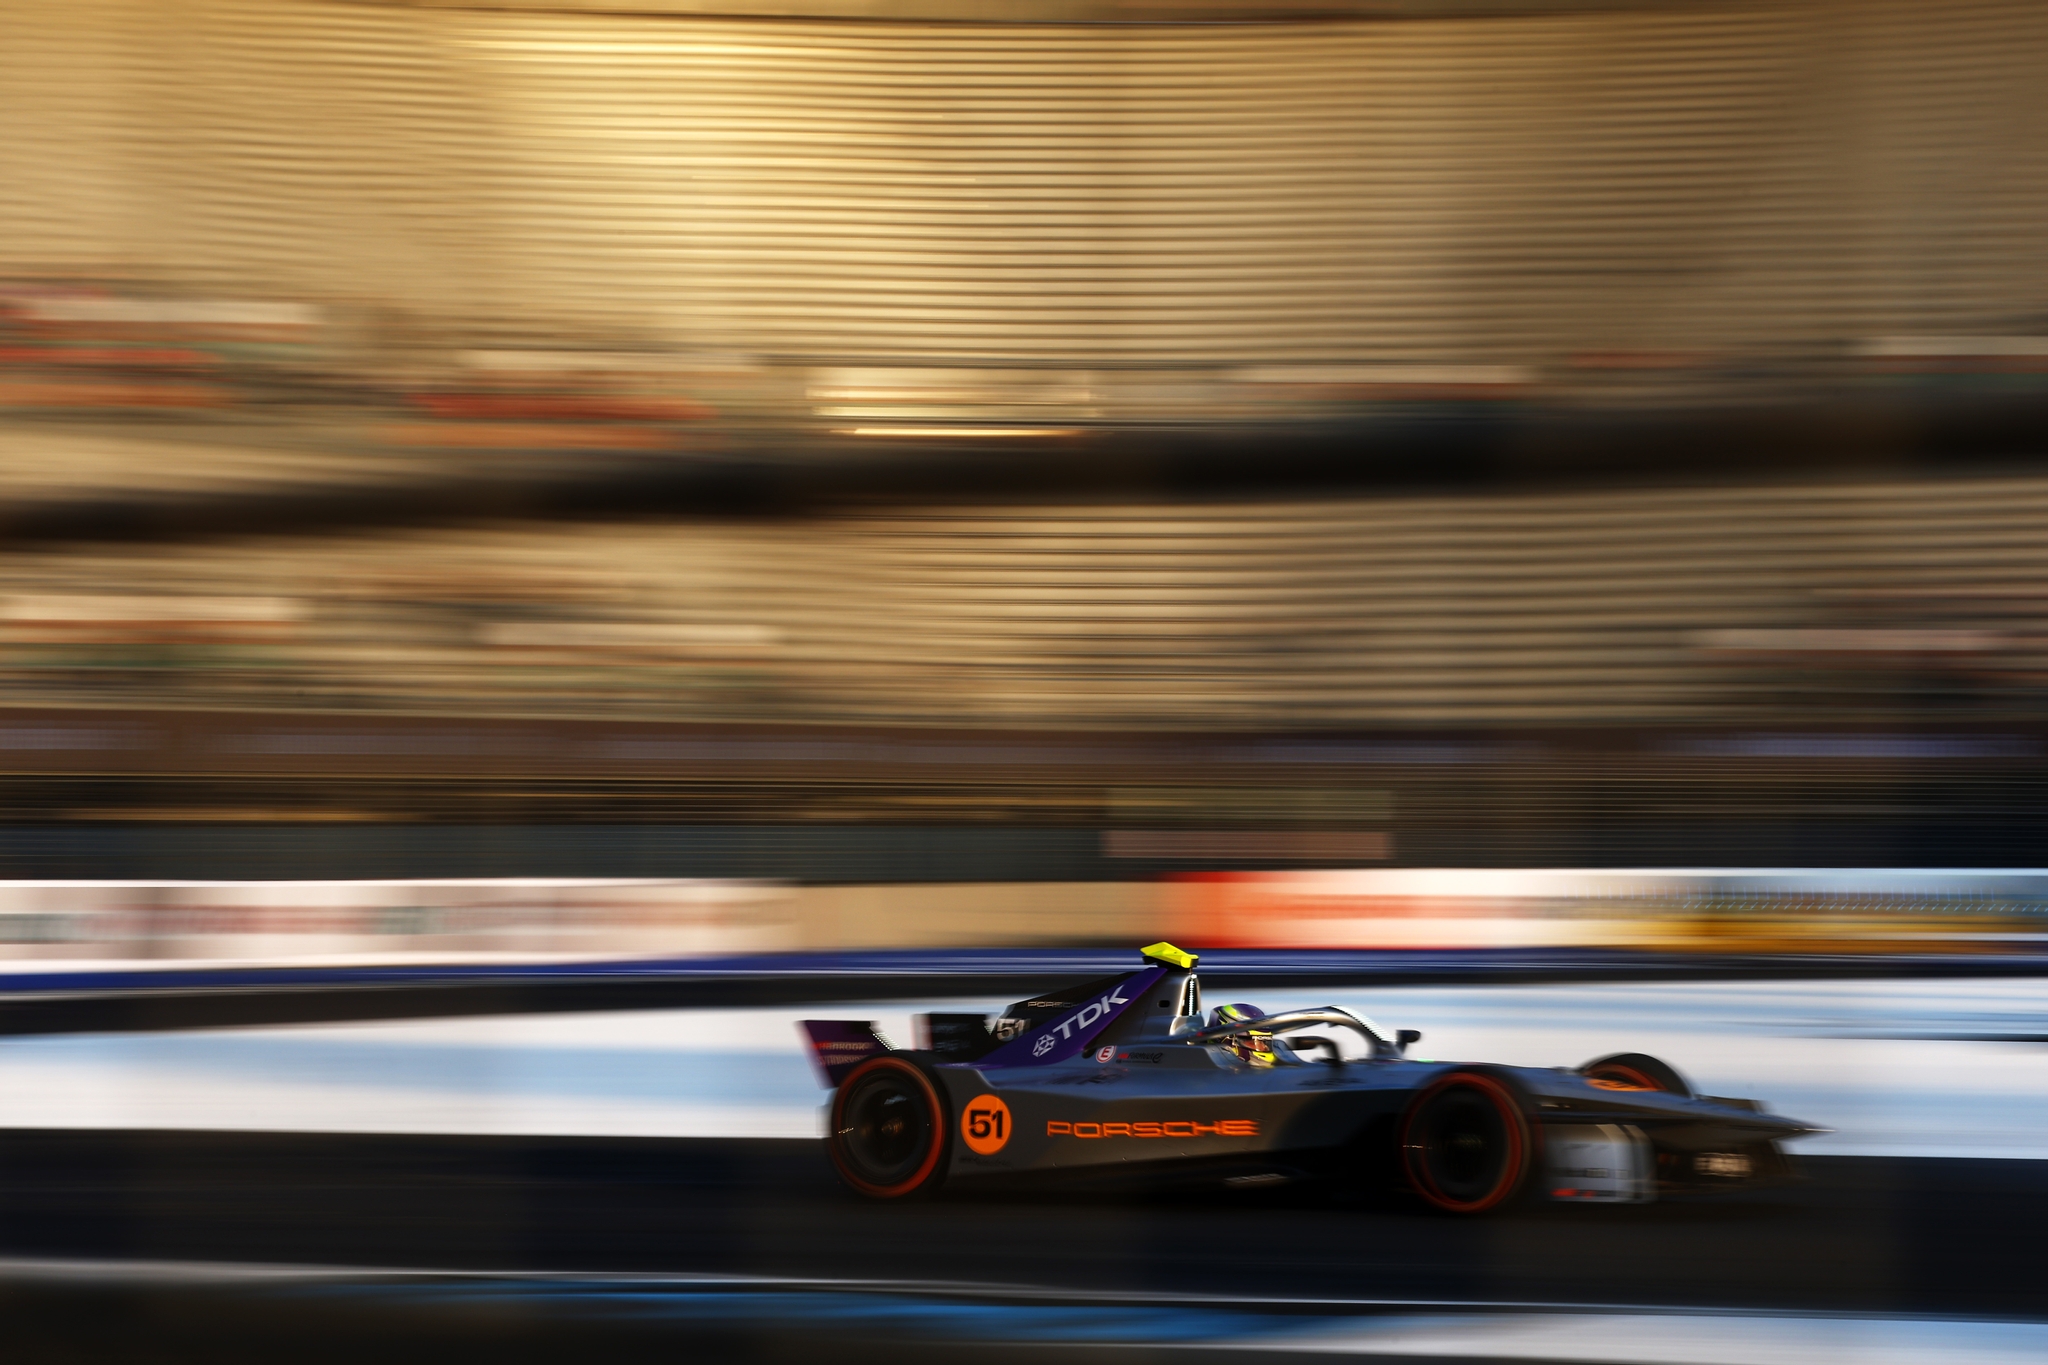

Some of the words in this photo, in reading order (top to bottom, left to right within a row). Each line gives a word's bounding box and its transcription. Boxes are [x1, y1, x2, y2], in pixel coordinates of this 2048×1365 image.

[1027, 1001, 1081, 1009] PORSCH
[1052, 984, 1130, 1040] TDK
[996, 1018, 1029, 1041] 51
[969, 1109, 1003, 1139] 51
[1046, 1120, 1260, 1138] PORSCHE
